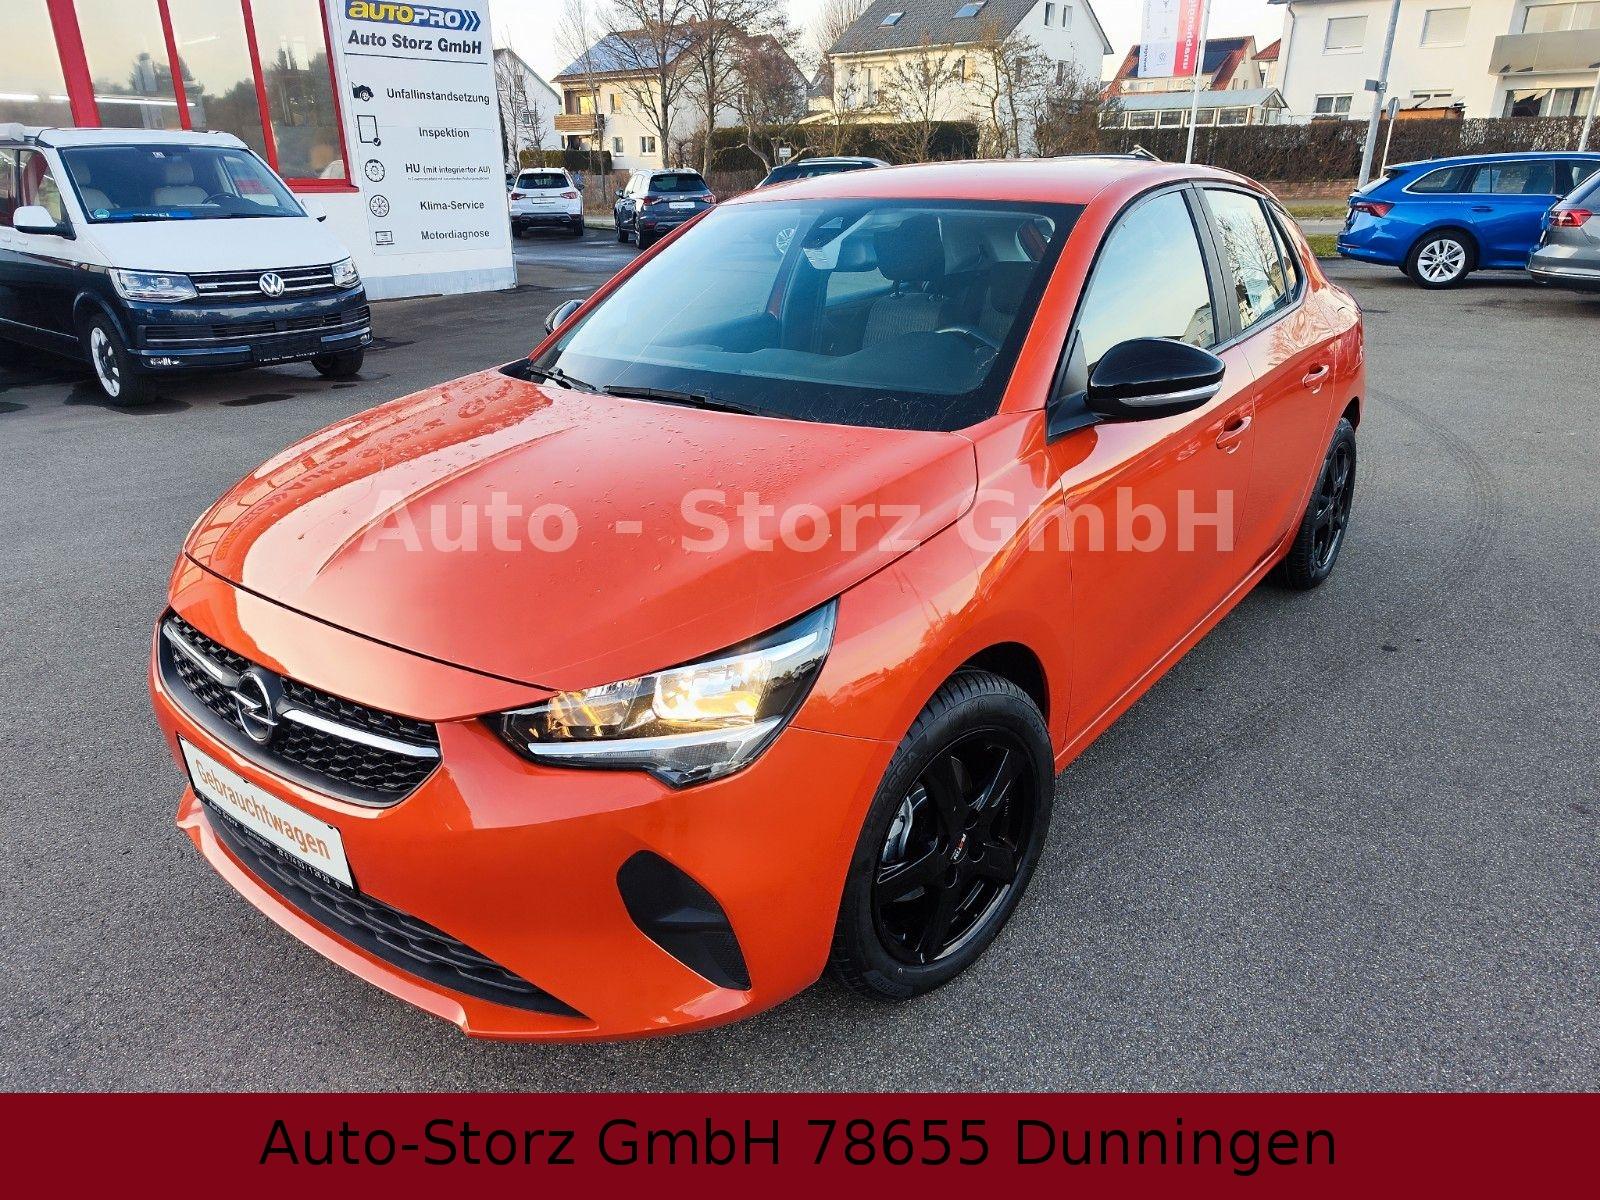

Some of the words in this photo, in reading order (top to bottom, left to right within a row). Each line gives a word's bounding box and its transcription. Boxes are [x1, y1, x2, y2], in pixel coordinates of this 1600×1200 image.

[347, 30, 387, 47] Auto
[392, 34, 433, 51] Storz
[437, 37, 482, 54] GmbH
[386, 88, 490, 105] Unfallinstandsetzung
[419, 127, 470, 140] Inspektion
[405, 163, 420, 173] HU
[420, 200, 485, 211] Klima-Service
[420, 230, 490, 241] Motordiagnose
[195, 759, 331, 860] Gebrauchtwagen
